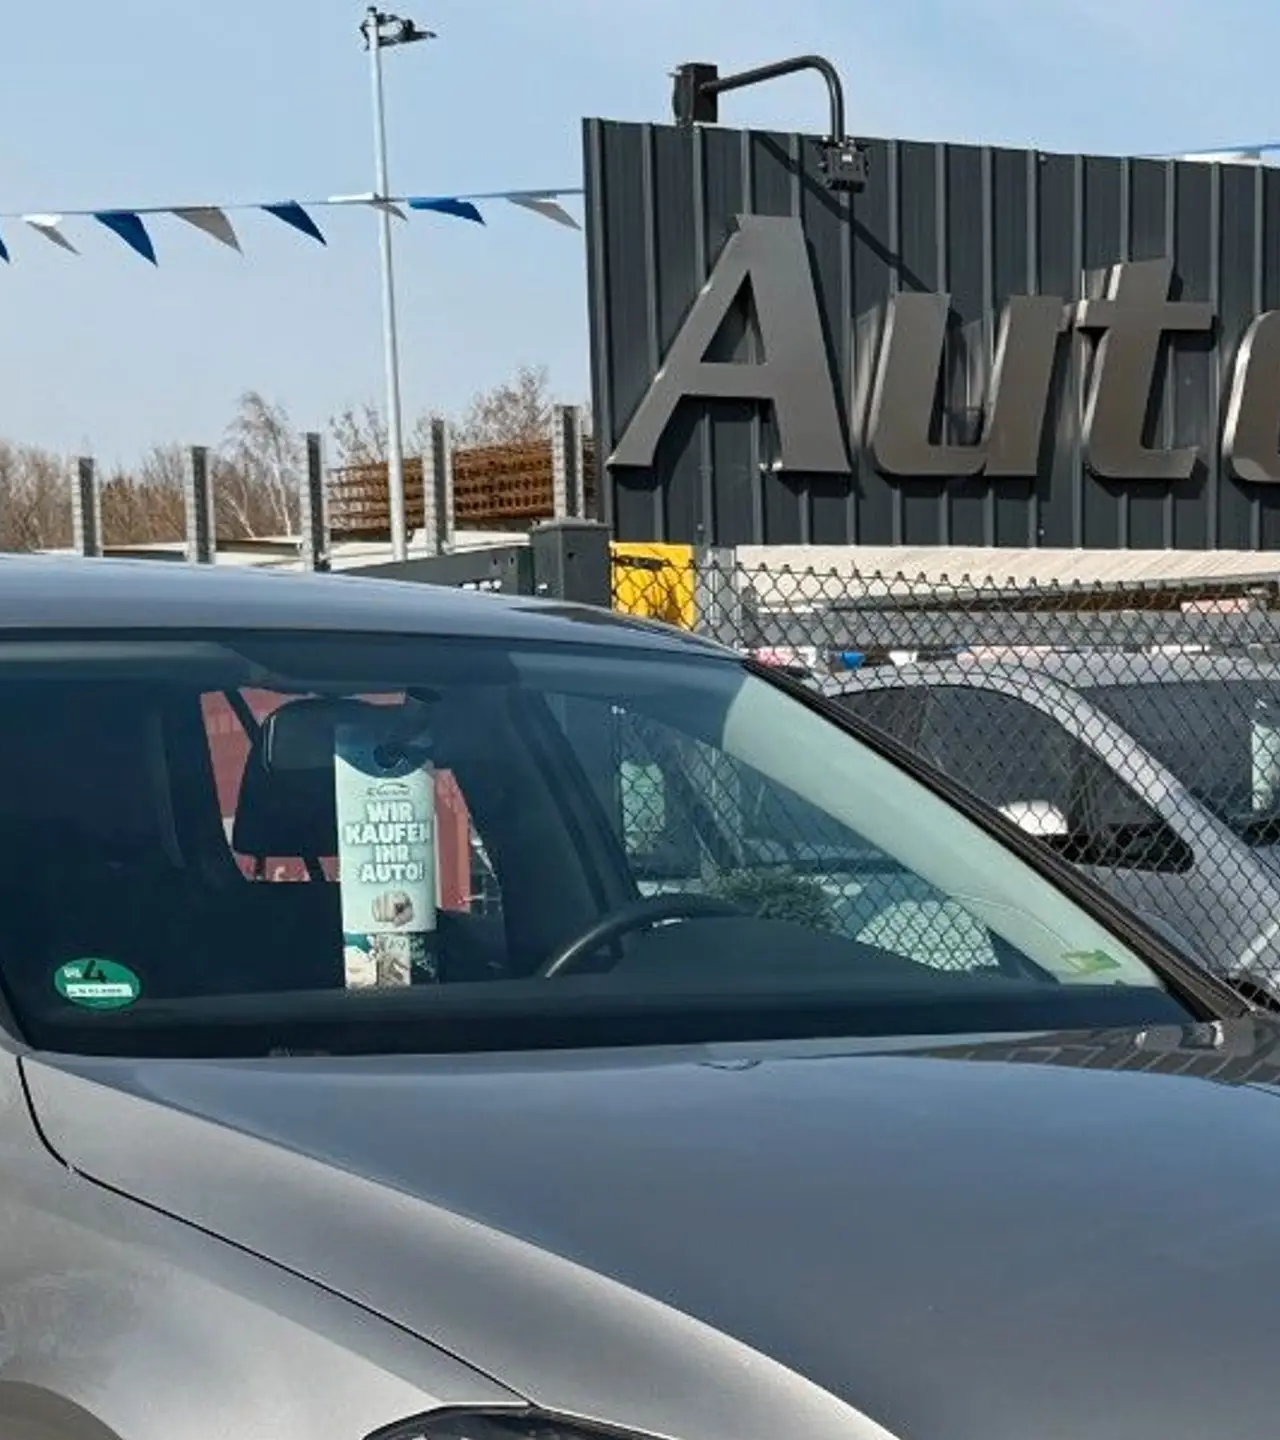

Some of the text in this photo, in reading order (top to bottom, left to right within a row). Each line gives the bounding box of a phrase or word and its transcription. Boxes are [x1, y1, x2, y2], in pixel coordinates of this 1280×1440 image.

[367, 801, 414, 823] WIR
[375, 844, 410, 862] IHR
[360, 862, 425, 883] AUTO!
